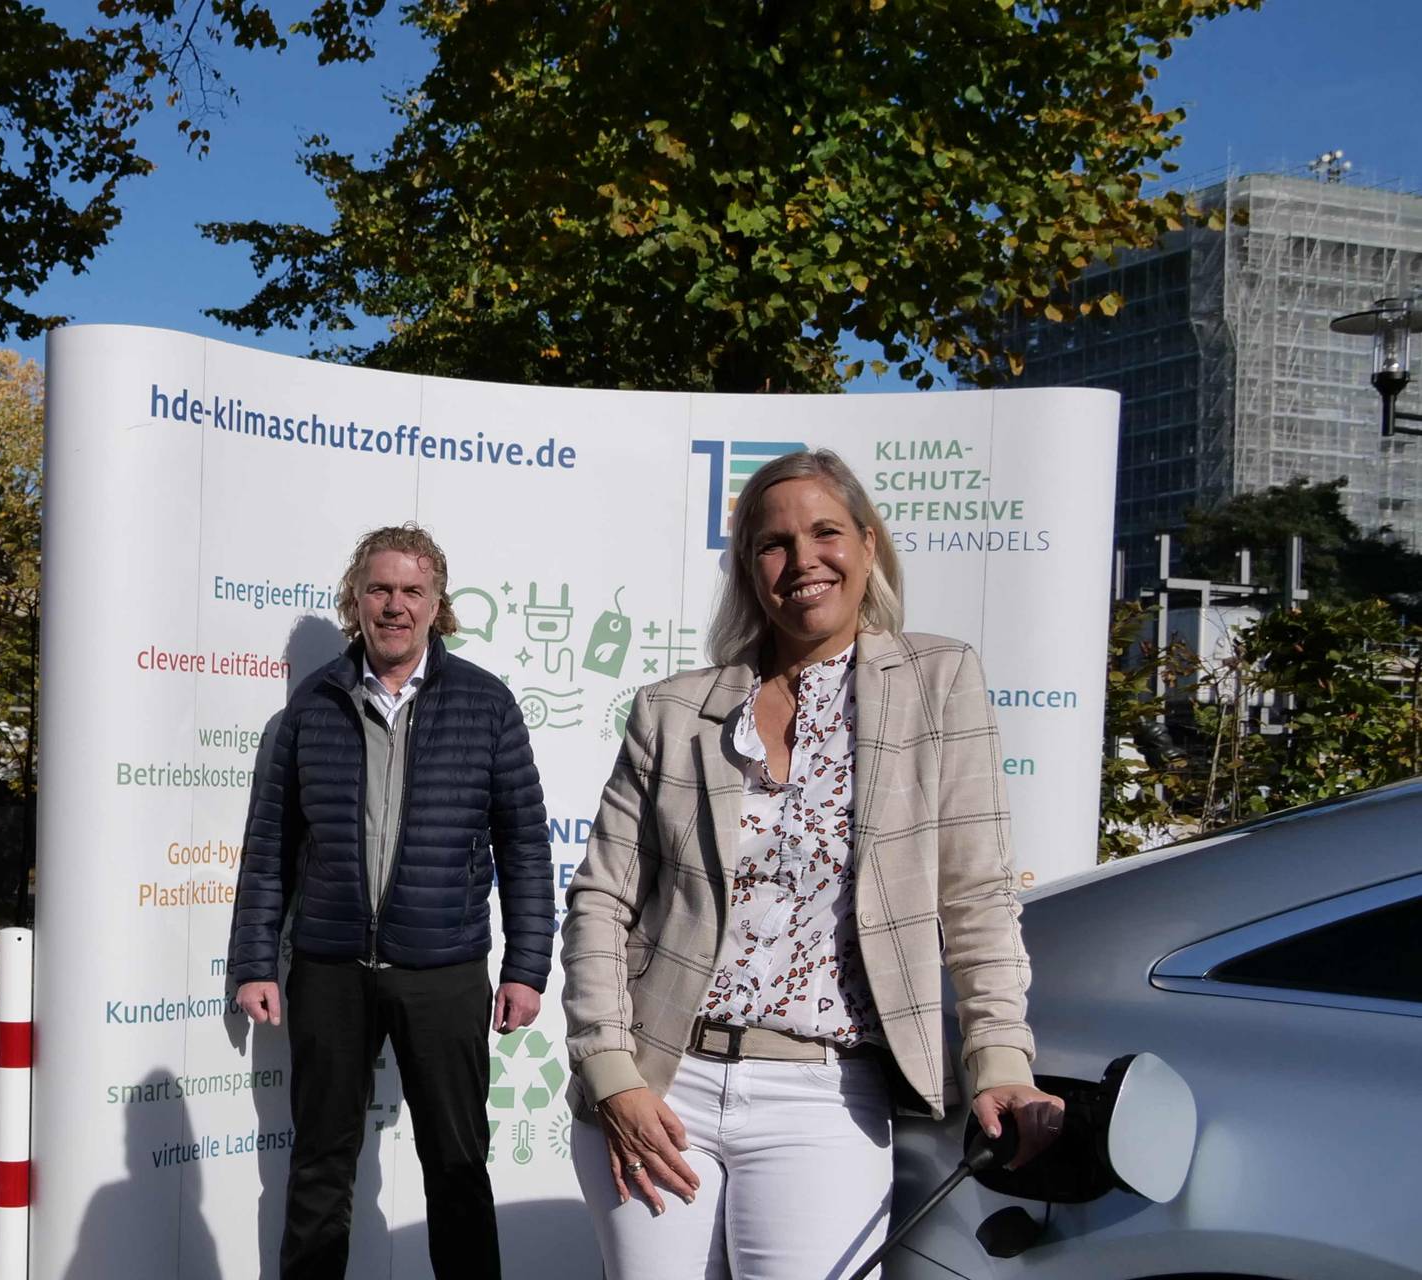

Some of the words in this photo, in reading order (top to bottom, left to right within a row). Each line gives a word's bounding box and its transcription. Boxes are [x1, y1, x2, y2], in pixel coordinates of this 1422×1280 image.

[151, 384, 576, 469] hde-klimaschutzoffensive.de
[875, 440, 973, 461] KLIMA-
[874, 470, 990, 491] SCHUTZ-
[876, 500, 1024, 521] OFFENSIVE
[928, 531, 1050, 552] HANDELS
[137, 645, 205, 673] clevere
[211, 652, 291, 679] Leitfäden
[198, 724, 267, 754] weniger
[117, 762, 257, 788] Betriebskosten
[107, 1077, 170, 1103] smart
[175, 1068, 284, 1099] Stromsparen
[153, 1135, 219, 1168] virtuelle
